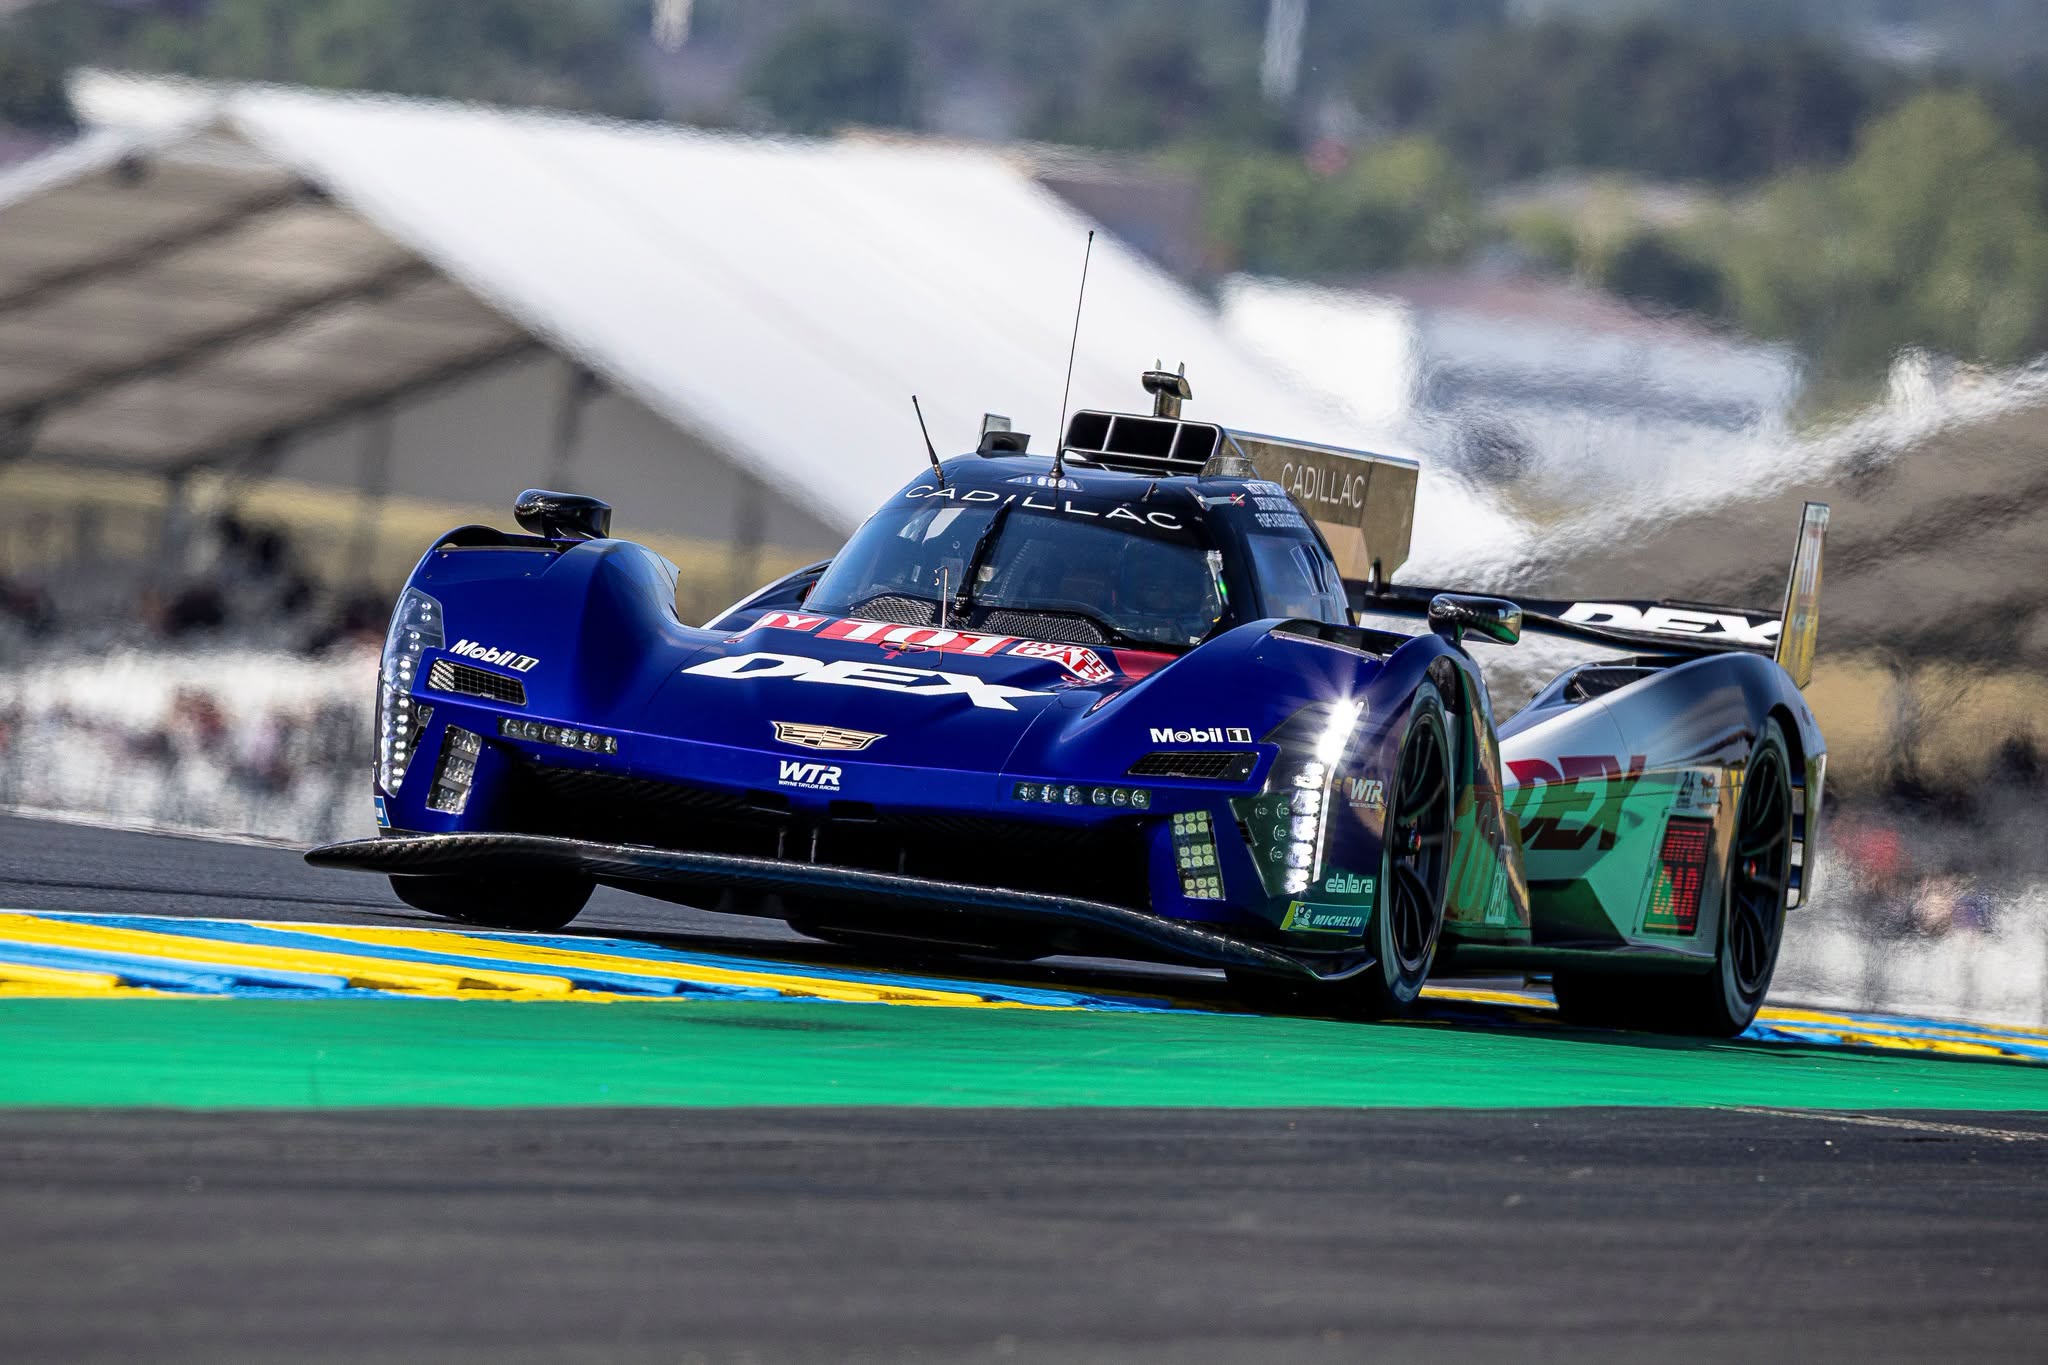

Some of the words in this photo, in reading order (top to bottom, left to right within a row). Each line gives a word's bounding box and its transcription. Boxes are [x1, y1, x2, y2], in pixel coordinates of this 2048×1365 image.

[1281, 462, 1365, 508] CADILLAC
[905, 485, 1183, 530] CADILLAC
[842, 619, 1005, 655] 101
[449, 639, 517, 666] Mobil
[681, 652, 1061, 712] DEX
[1150, 728, 1223, 743] Mobil
[780, 760, 842, 786] WTR
[1351, 778, 1383, 802] WTR
[1505, 754, 1647, 850] DEX
[1325, 873, 1373, 893] dallara
[1312, 914, 1362, 927] MICHELIN
